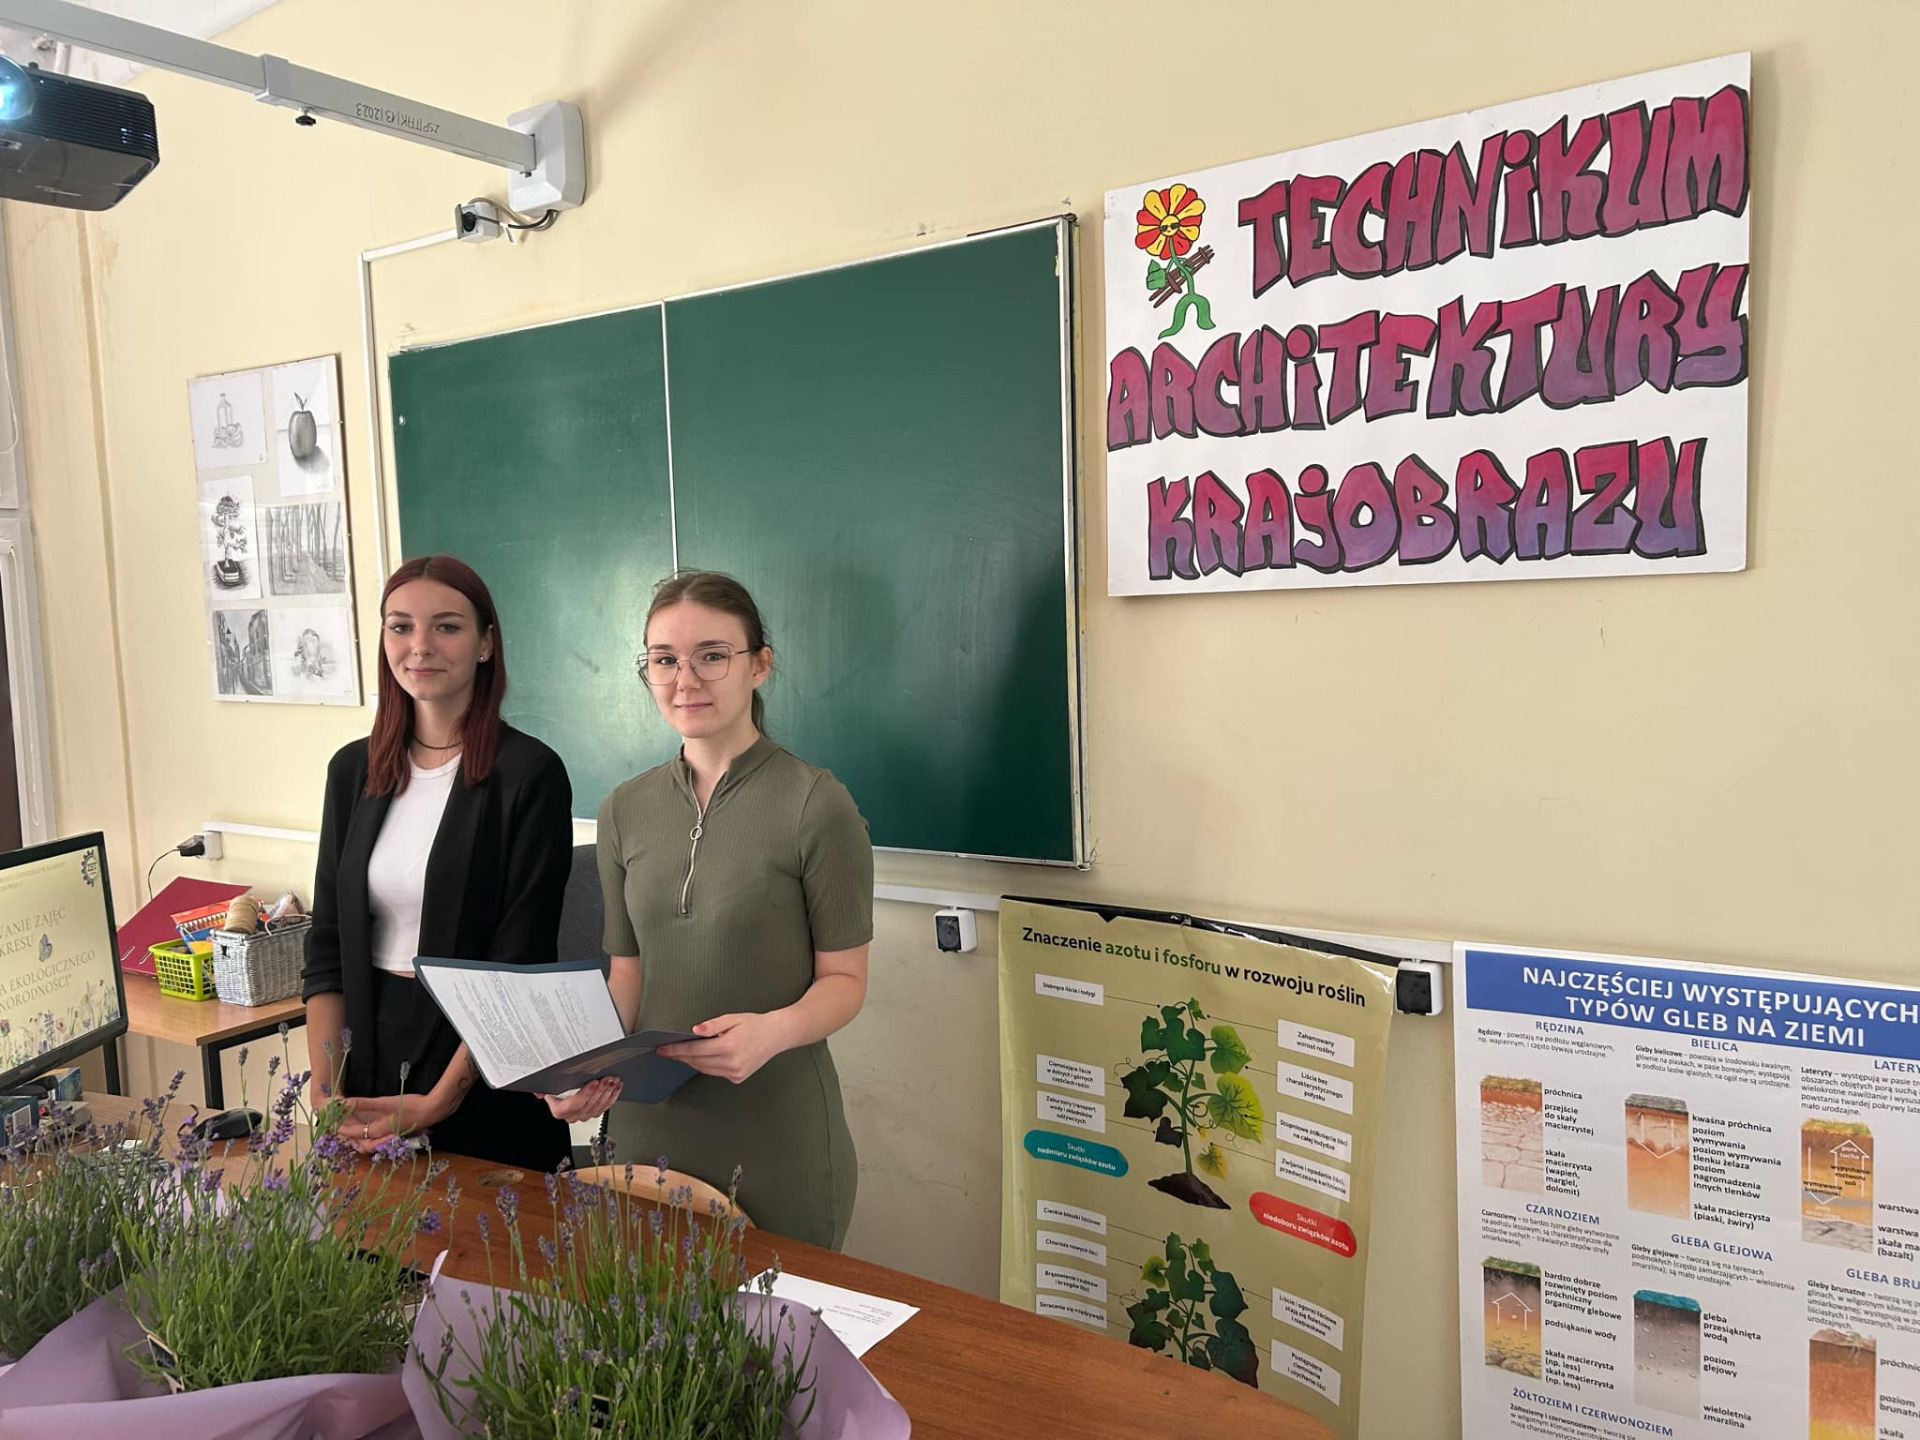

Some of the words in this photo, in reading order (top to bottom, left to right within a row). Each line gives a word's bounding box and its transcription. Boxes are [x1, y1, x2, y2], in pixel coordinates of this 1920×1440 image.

[1022, 926, 1102, 953] Znaczenie
[1105, 943, 1151, 962] azotu
[1154, 947, 1159, 963] i
[1162, 950, 1221, 976] fosforu
[1224, 965, 1239, 979] w
[1243, 967, 1313, 996] rozwoju
[1317, 980, 1366, 1008] roślin
[1523, 967, 1673, 999] NAJCZĘŚCIEJ
[1682, 982, 1919, 1024] WYSTĘPUJĄCYCH
[1535, 1021, 1584, 1035] RĘDZINA
[1565, 996, 1655, 1023] TYPÓW
[1663, 1009, 1728, 1032] GLEB
[1737, 1016, 1776, 1038] NA
[1784, 1021, 1864, 1047] ZIEMI
[1691, 1038, 1739, 1052] BIELICA
[1544, 1089, 1583, 1100] próchnica
[1545, 1104, 1579, 1114] przejście
[1557, 1112, 1577, 1124] skały
[1692, 1114, 1726, 1126] kwaśna
[1728, 1121, 1772, 1133] próchnica
[1545, 1122, 1594, 1135] macierzystej
[1692, 1127, 1725, 1137] poziom
[1692, 1137, 1746, 1150] wymywania
[1545, 1149, 1566, 1158] skała
[1693, 1146, 1725, 1157] poziom
[1727, 1153, 1782, 1166] wymywania
[1545, 1159, 1593, 1172] macierzysta
[1693, 1154, 1721, 1165] tlenku
[1723, 1159, 1750, 1170] żelaza
[1693, 1164, 1726, 1175] poziom
[1545, 1166, 1580, 1179] (wapień,
[1546, 1176, 1578, 1187] margiel,
[1693, 1174, 1761, 1190] nagromadzenia
[1546, 1184, 1580, 1197] dolomit)
[1694, 1181, 1722, 1192] innych
[1724, 1187, 1761, 1199] tlenków
[1526, 1204, 1600, 1225] CZARNOZIEM
[1694, 1203, 1716, 1213] skała
[1718, 1208, 1771, 1222] macierzysta
[1878, 1204, 1920, 1215] warstwa
[1296, 1213, 1317, 1226] Skutki
[1694, 1212, 1725, 1225] (piaski,
[1727, 1218, 1754, 1230] żwiry)
[1878, 1226, 1919, 1238] warstwa
[1671, 1234, 1710, 1250] GLEBA
[1713, 1242, 1773, 1261] GLEJOWA
[1877, 1238, 1902, 1248] skała
[1877, 1247, 1914, 1261] (bazalt)
[1545, 1271, 1572, 1282] bardzo
[1573, 1277, 1601, 1289] dobrze
[1846, 1268, 1889, 1284] GLEBA
[1545, 1281, 1586, 1295] rozwinięty
[1588, 1290, 1618, 1301] poziom
[1545, 1290, 1592, 1306] próchniczny
[1545, 1299, 1586, 1313] organizmy
[1587, 1307, 1622, 1320] glebowe
[1703, 1313, 1727, 1324] gleba
[1545, 1319, 1592, 1334] podsiąkanie
[1594, 1331, 1617, 1341] wody
[1703, 1323, 1761, 1340] przesiąknięta
[1703, 1332, 1728, 1344] wodą
[1545, 1350, 1565, 1362] skała
[1567, 1355, 1614, 1371] macierzysta
[1545, 1357, 1561, 1367] (np.
[1563, 1361, 1581, 1373] less)
[1703, 1355, 1736, 1367] poziom
[1703, 1364, 1737, 1378] glejowy
[1546, 1368, 1566, 1381] skała
[1567, 1374, 1614, 1390] macierzysta
[1546, 1375, 1561, 1385] (np.
[1563, 1380, 1581, 1392] less)
[1879, 1395, 1916, 1408] poziom
[1513, 1388, 1572, 1411] ŻÓŁTOZIEM
[1575, 1404, 1578, 1413] I
[1581, 1407, 1673, 1436] CZERWONOZIEM
[1703, 1405, 1752, 1421] wieloletnia
[1703, 1414, 1745, 1429] zmarzlina
[1879, 1428, 1904, 1439] skała
